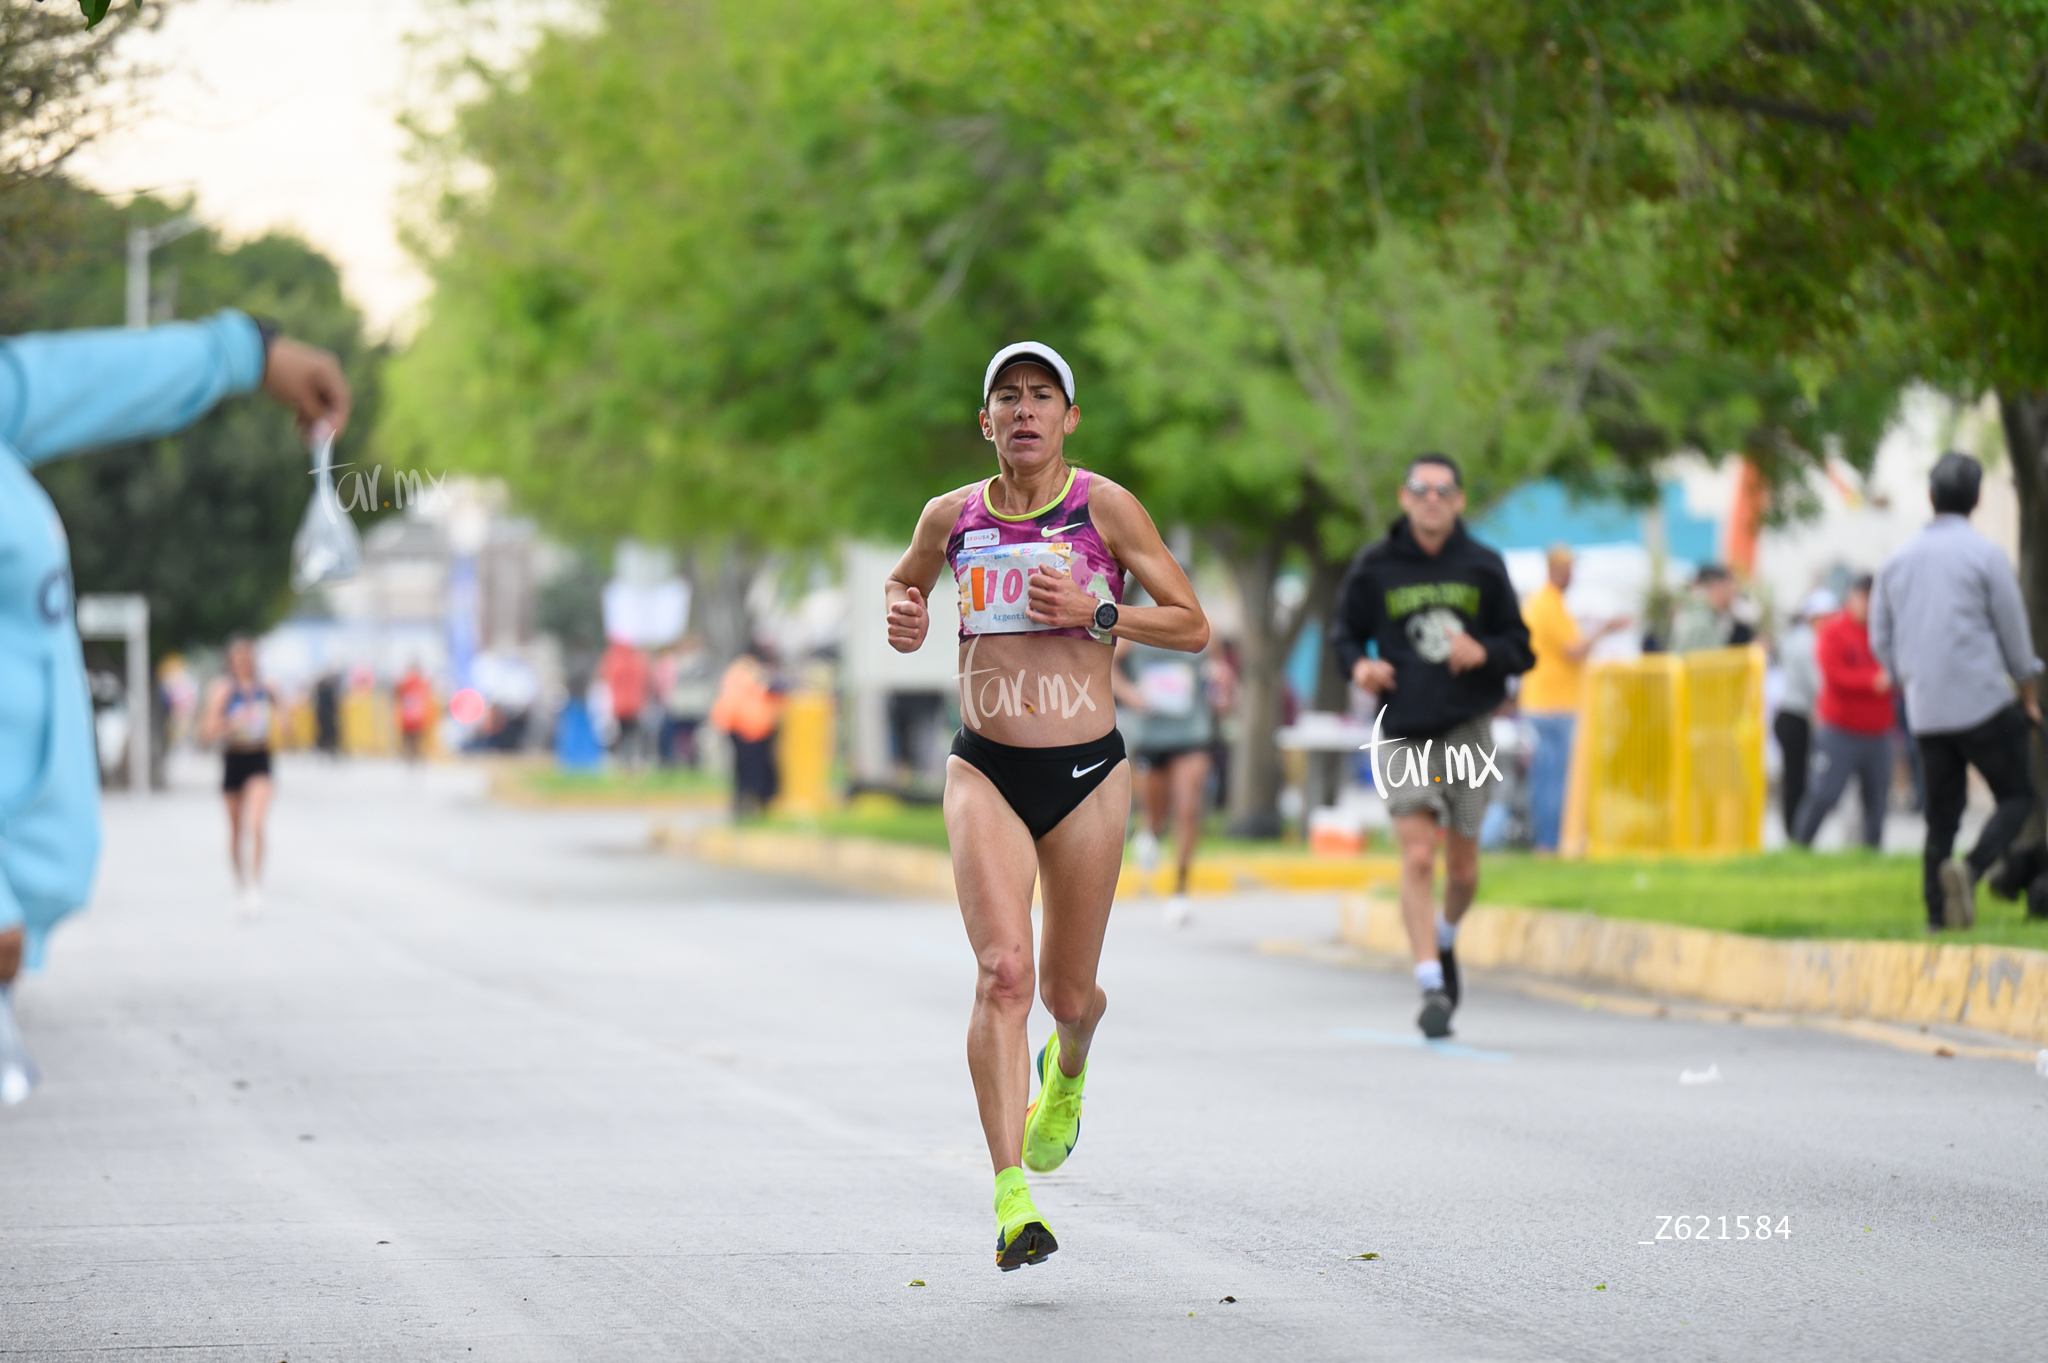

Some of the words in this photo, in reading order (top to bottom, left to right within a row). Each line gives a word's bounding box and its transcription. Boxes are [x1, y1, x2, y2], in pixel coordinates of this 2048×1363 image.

[966, 534, 990, 542] SEGUSA
[986, 568, 1040, 604] 10
[993, 612, 1029, 622] Argenti
